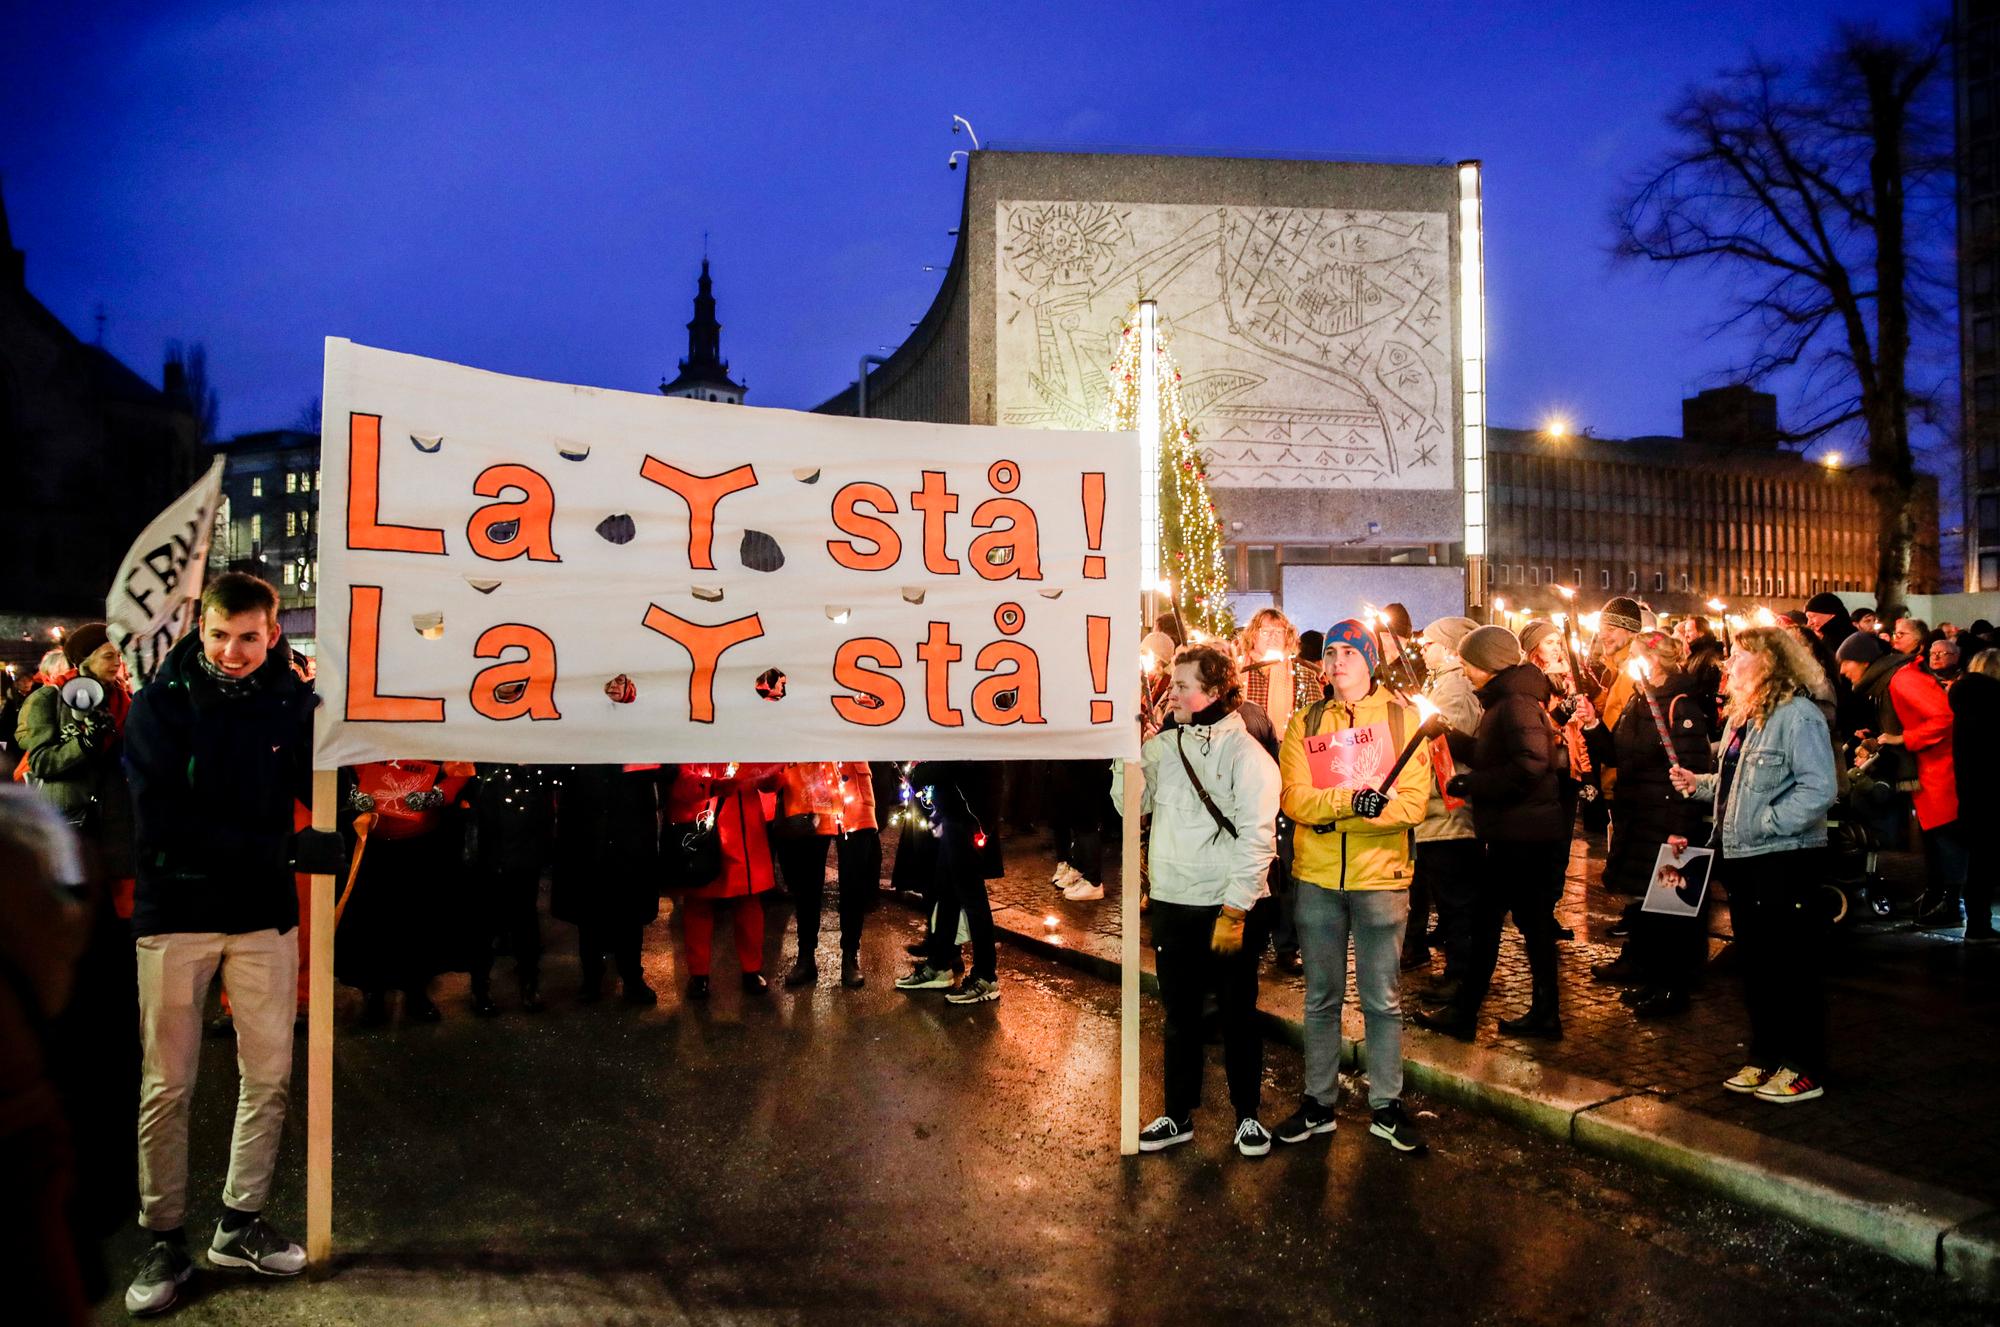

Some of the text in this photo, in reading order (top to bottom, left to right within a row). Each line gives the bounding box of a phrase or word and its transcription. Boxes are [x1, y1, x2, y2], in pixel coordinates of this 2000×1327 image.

[347, 411, 562, 563] La
[345, 584, 561, 722] La
[1308, 740, 1327, 754] La
